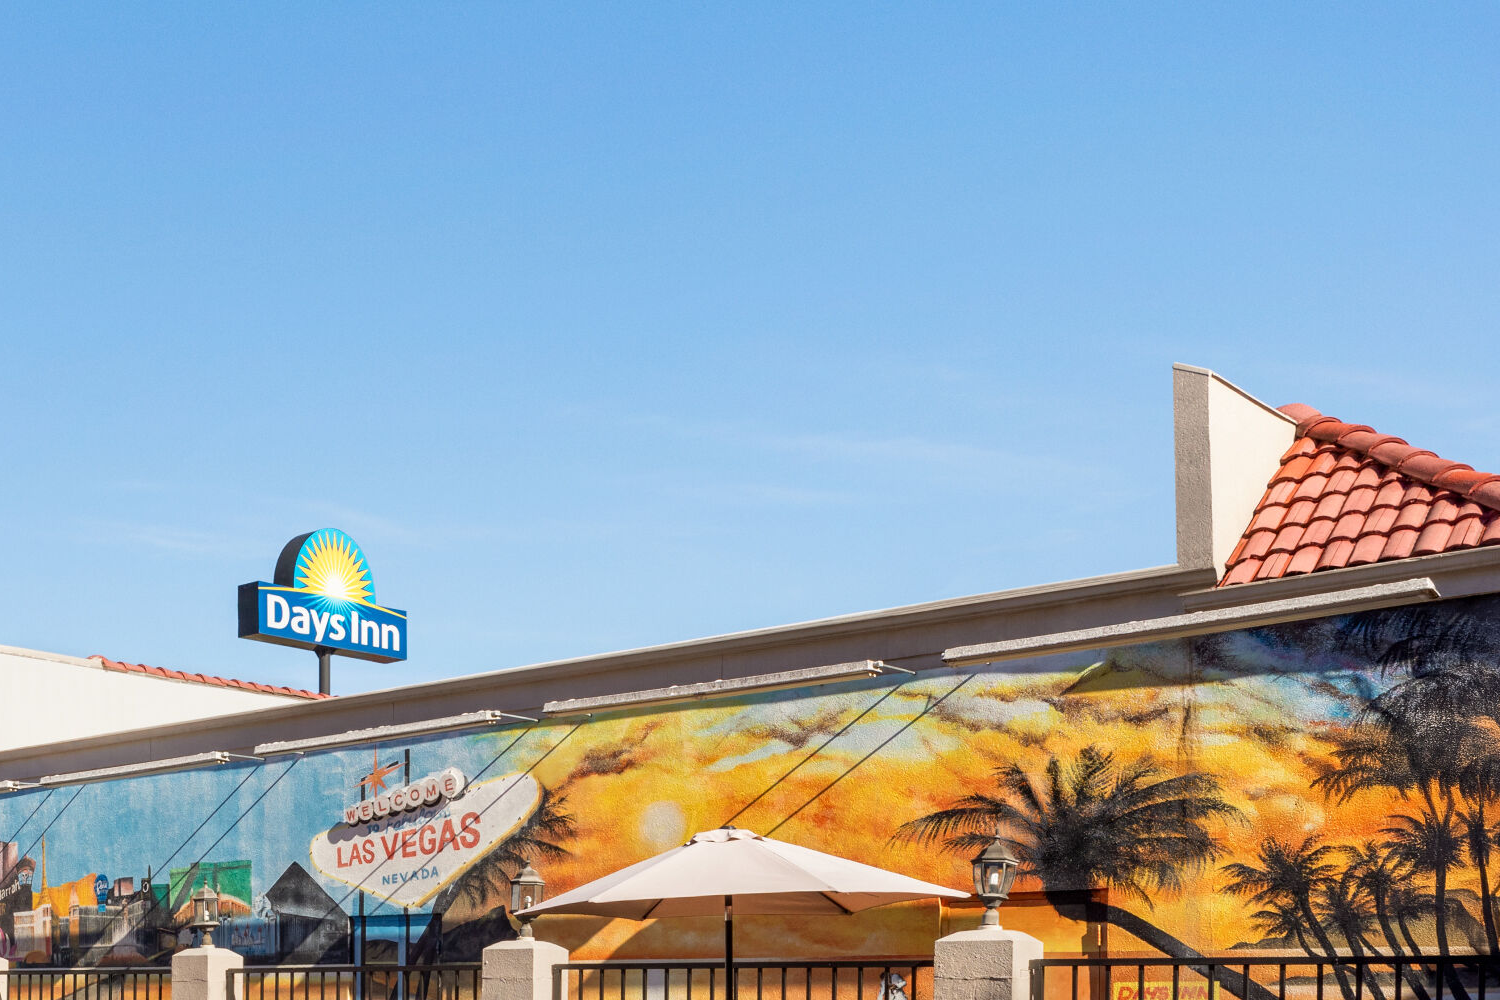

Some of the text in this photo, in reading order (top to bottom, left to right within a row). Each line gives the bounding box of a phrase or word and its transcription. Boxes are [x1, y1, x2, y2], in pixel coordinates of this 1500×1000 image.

[266, 593, 400, 652] Days Inn
[346, 778, 454, 822] WELCOME
[337, 811, 482, 869] LAS VEGAS
[382, 866, 440, 885] NEVADA
